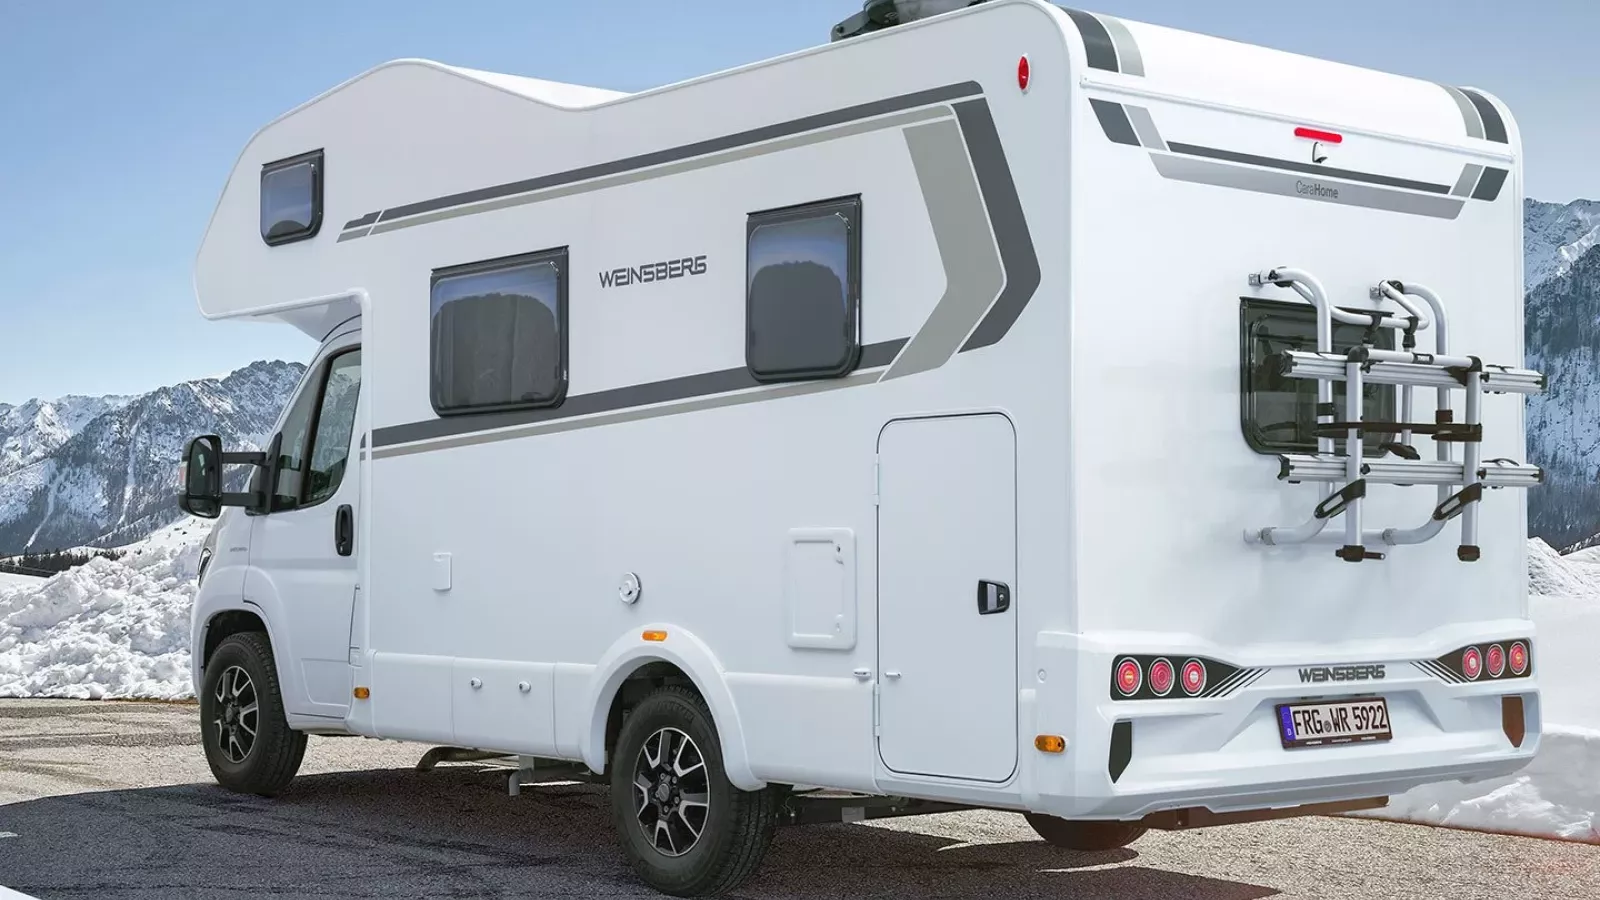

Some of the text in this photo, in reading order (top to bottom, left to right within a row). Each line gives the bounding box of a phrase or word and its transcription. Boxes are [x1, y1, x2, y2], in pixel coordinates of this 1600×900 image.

[599, 254, 707, 289] WEINSBERG
[1298, 664, 1386, 683] WEINSBERG
[1293, 705, 1387, 735] FRG WR 5922
